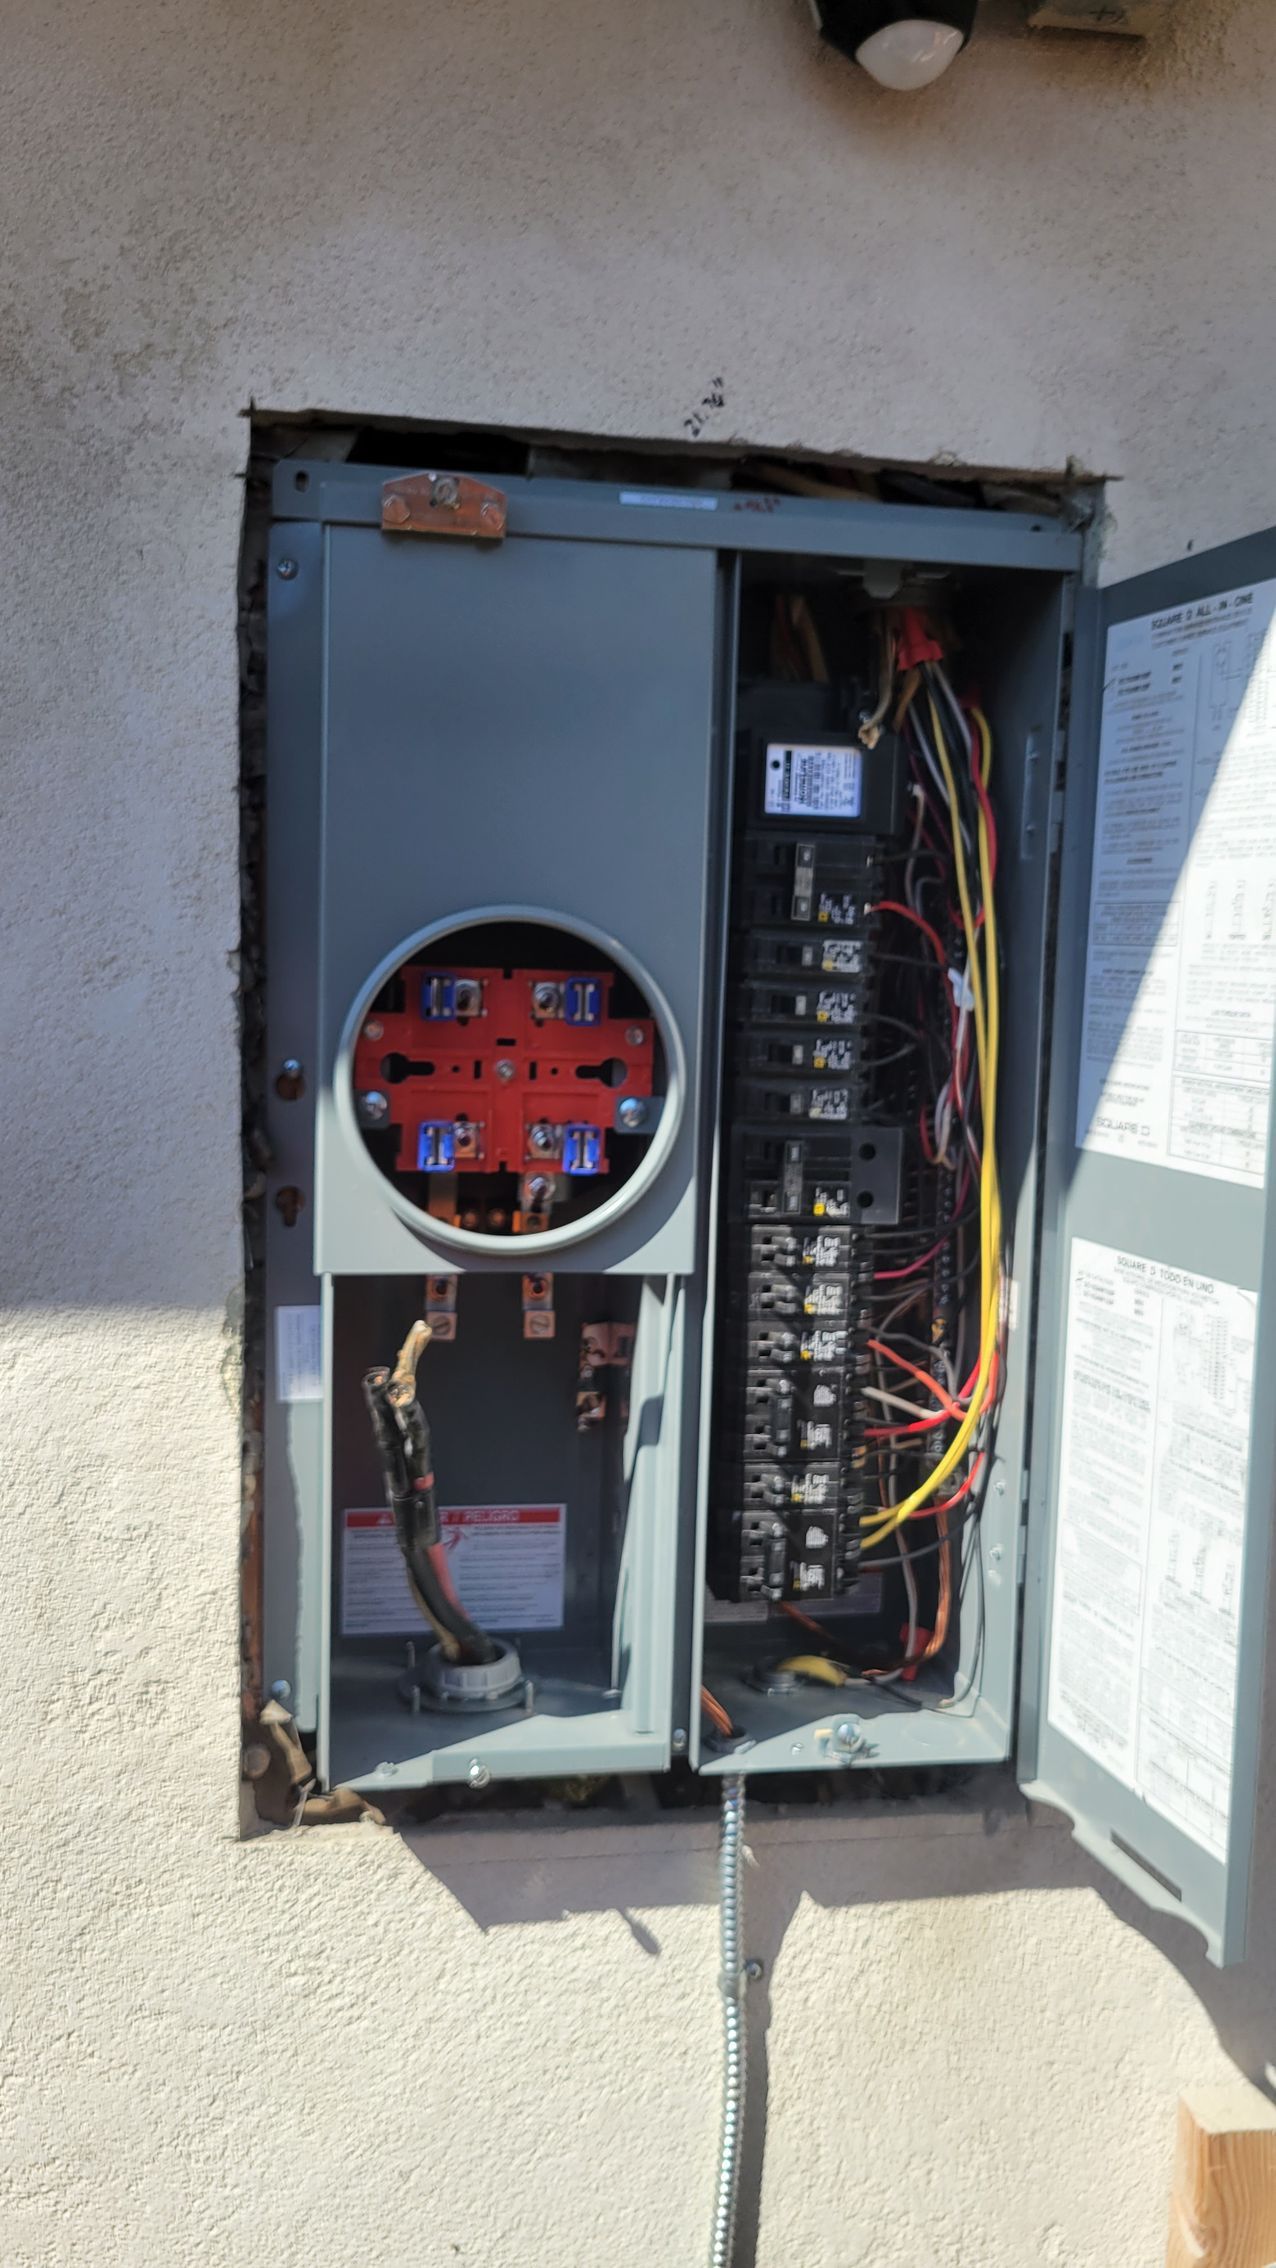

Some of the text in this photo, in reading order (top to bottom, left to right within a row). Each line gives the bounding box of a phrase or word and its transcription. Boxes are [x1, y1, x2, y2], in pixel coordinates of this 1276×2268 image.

[1117, 1255, 1147, 1273] SQUARE
[1160, 1269, 1182, 1285] TODO
[1184, 1276, 1195, 1288] EN
[1196, 1282, 1215, 1295] UNO
[463, 1510, 520, 1522] PELIGRO
